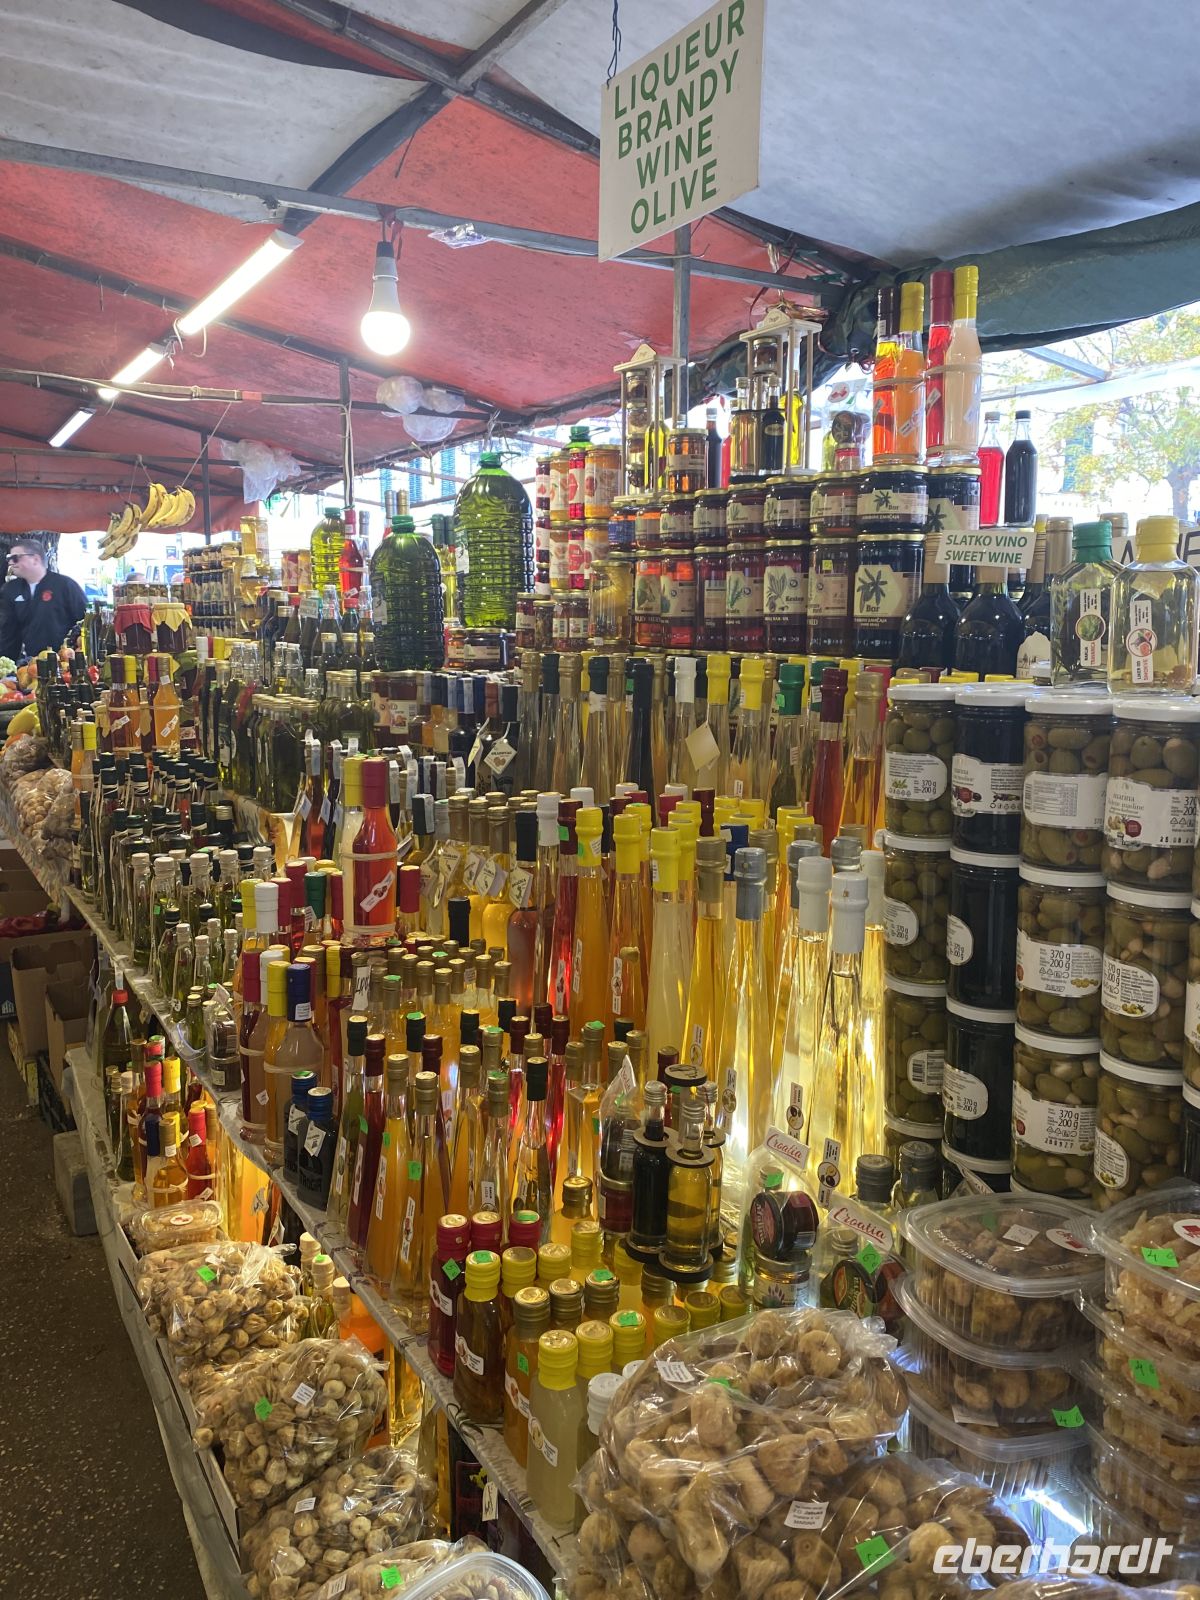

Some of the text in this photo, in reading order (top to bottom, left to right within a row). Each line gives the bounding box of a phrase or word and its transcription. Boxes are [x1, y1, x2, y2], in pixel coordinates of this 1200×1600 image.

[614, 0, 745, 120] LIQUEUR
[618, 49, 739, 160] BRANDY
[636, 114, 713, 189] WINE
[630, 159, 717, 234] OLIVE
[945, 534, 1028, 548] SLATKO VINO
[944, 549, 1023, 565] SWEET WINE
[921, 779, 932, 787] 370
[921, 786, 932, 794] 200
[1050, 949, 1071, 961] 370 g
[1049, 959, 1071, 971] 200 g
[1059, 1109, 1080, 1120] 370 g
[1058, 1119, 1079, 1130] 200 g
[766, 1133, 802, 1159] Croatia
[833, 1207, 887, 1241] Croatia
